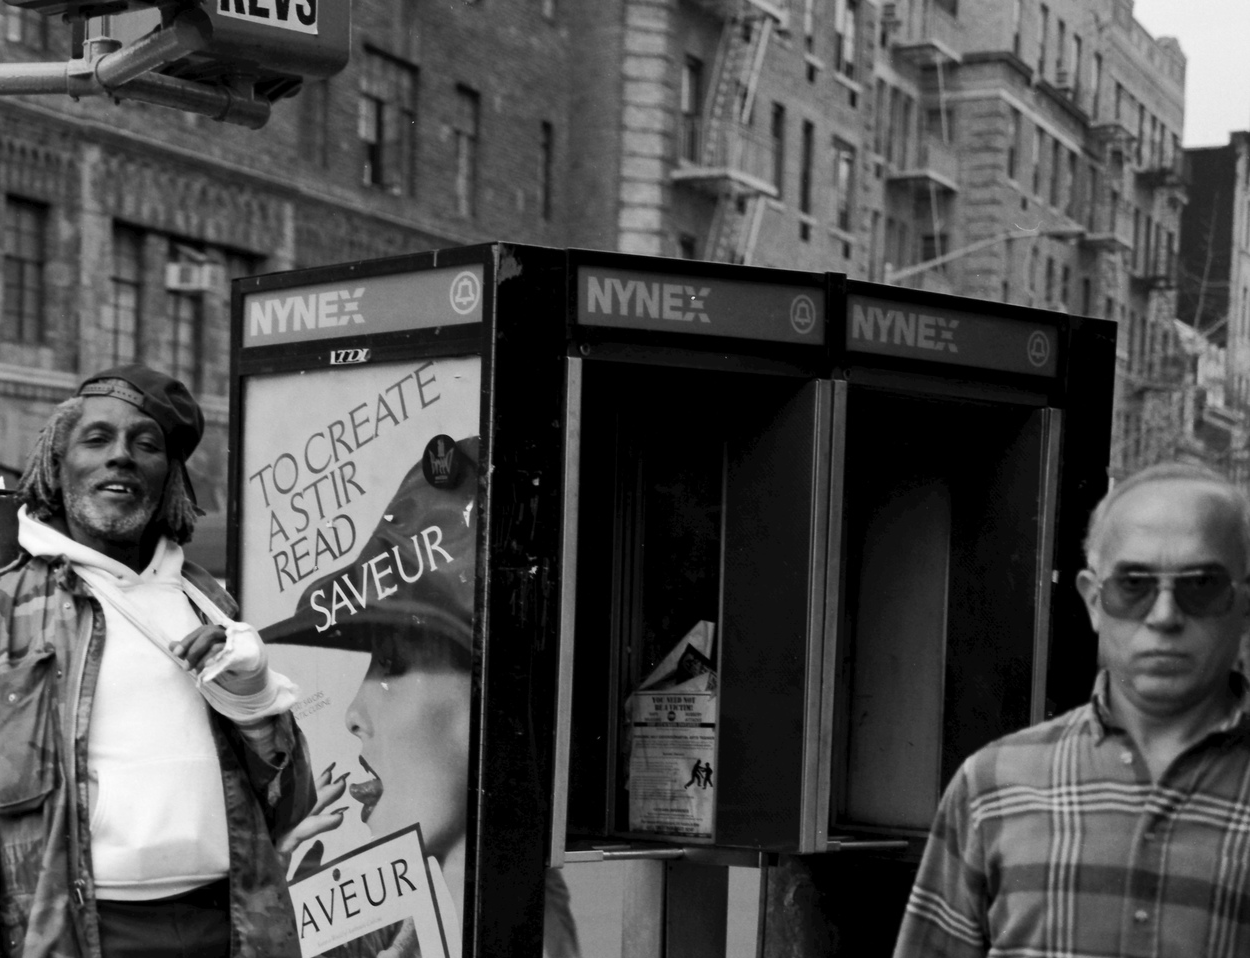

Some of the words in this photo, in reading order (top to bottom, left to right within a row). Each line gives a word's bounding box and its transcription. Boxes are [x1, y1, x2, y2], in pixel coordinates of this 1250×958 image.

[250, 286, 366, 337] NYNEX
[587, 276, 711, 323] NYNEX
[852, 304, 959, 353] NYNEX
[250, 453, 299, 508] TO
[304, 361, 441, 474] CREATE
[269, 510, 290, 552] A
[290, 461, 366, 534] STIR
[273, 514, 356, 593] READ
[310, 525, 454, 633] SAVEUR
[301, 859, 417, 939] AVEUR
